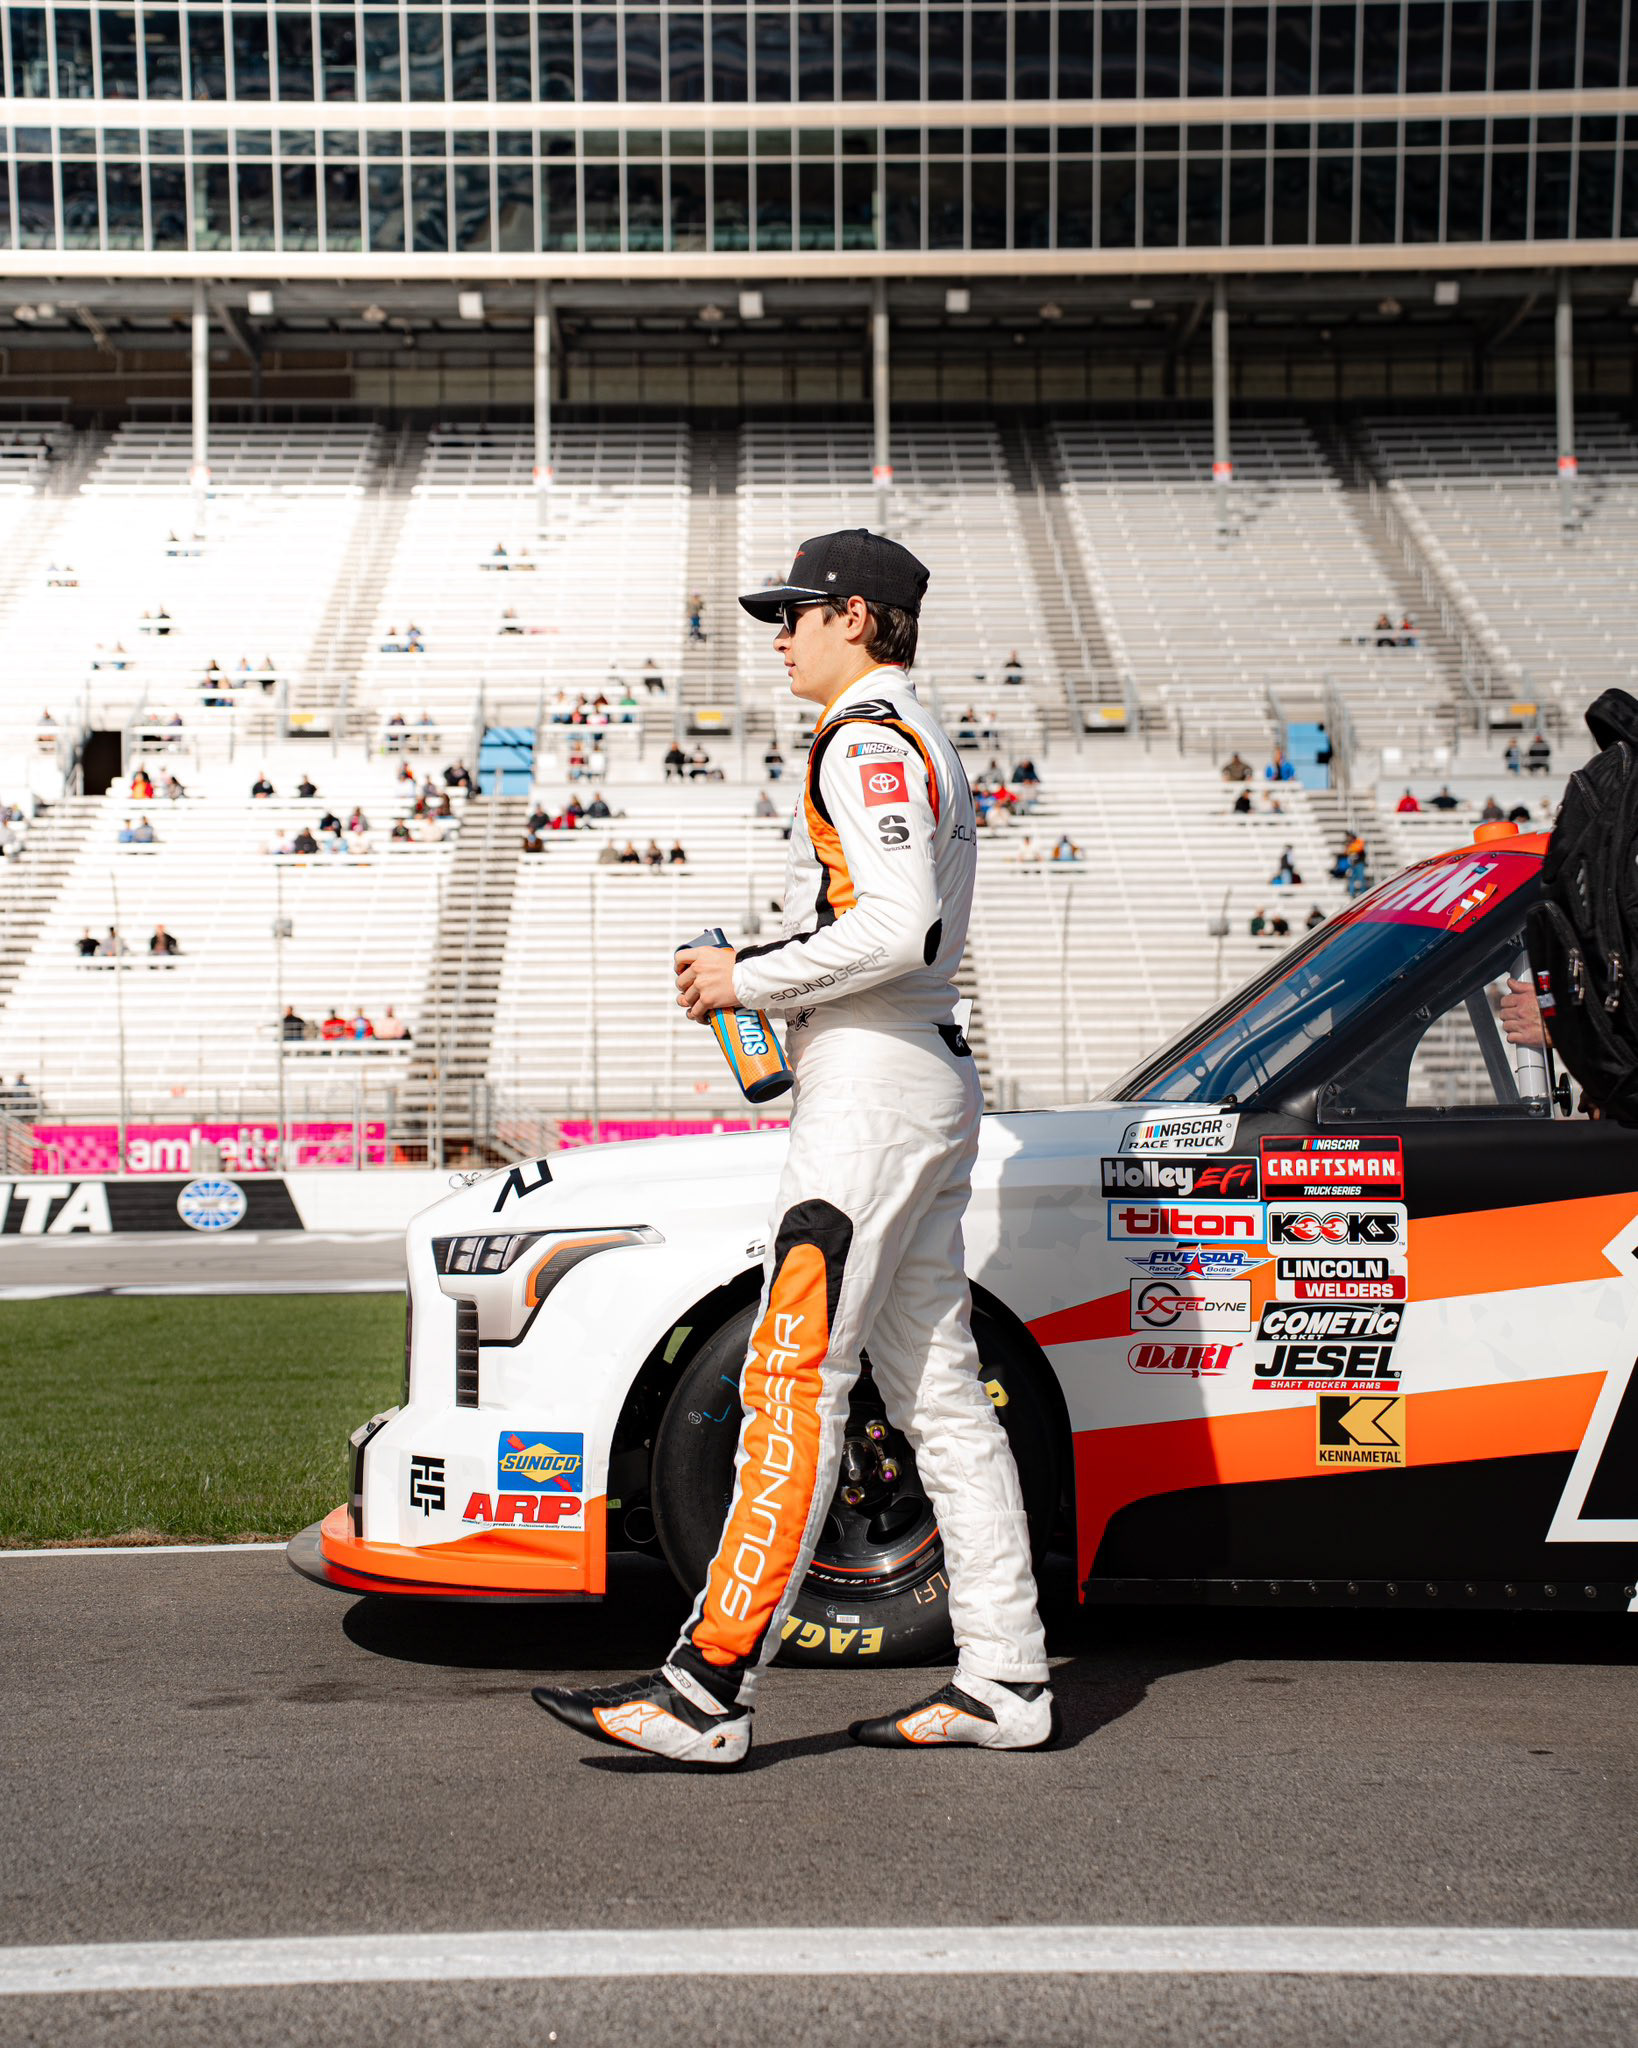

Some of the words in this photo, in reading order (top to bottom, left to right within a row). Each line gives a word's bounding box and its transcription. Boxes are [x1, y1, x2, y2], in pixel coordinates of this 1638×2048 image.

[771, 947, 889, 1001] SOUNDGEAR
[1160, 1120, 1222, 1138] NASCAR
[1128, 1139, 1168, 1149] RACE
[1174, 1136, 1225, 1147] TRUCK
[1317, 1139, 1360, 1150] NASCAR
[1267, 1158, 1395, 1176] CRAFTSMAN
[1103, 1161, 1193, 1196] Holley
[1193, 1164, 1252, 1194] EFI
[1303, 1186, 1331, 1195] TRUCK
[1331, 1186, 1362, 1195] SERIES
[0, 1181, 113, 1234] TA
[1118, 1208, 1255, 1236] tilton
[1269, 1212, 1399, 1244] KOOKS
[1149, 1251, 1196, 1265] FIVE
[1199, 1252, 1244, 1266] STAR
[1206, 1265, 1237, 1273] Bodies
[1282, 1260, 1383, 1278] LINCOLN
[1305, 1283, 1394, 1297] WELDERS
[1263, 1310, 1400, 1335] COMETIC
[1135, 1343, 1243, 1369] DART
[1255, 1345, 1402, 1378] JESEL
[1270, 1380, 1302, 1389] SHAFT
[1307, 1381, 1347, 1389] ROCKER
[1352, 1381, 1381, 1389] ARMS
[503, 1455, 578, 1471] SUNOCO
[1319, 1450, 1401, 1463] KENNAMETAL
[720, 1313, 804, 1621] SOUNDGEAR
[463, 1491, 582, 1523] ARP
